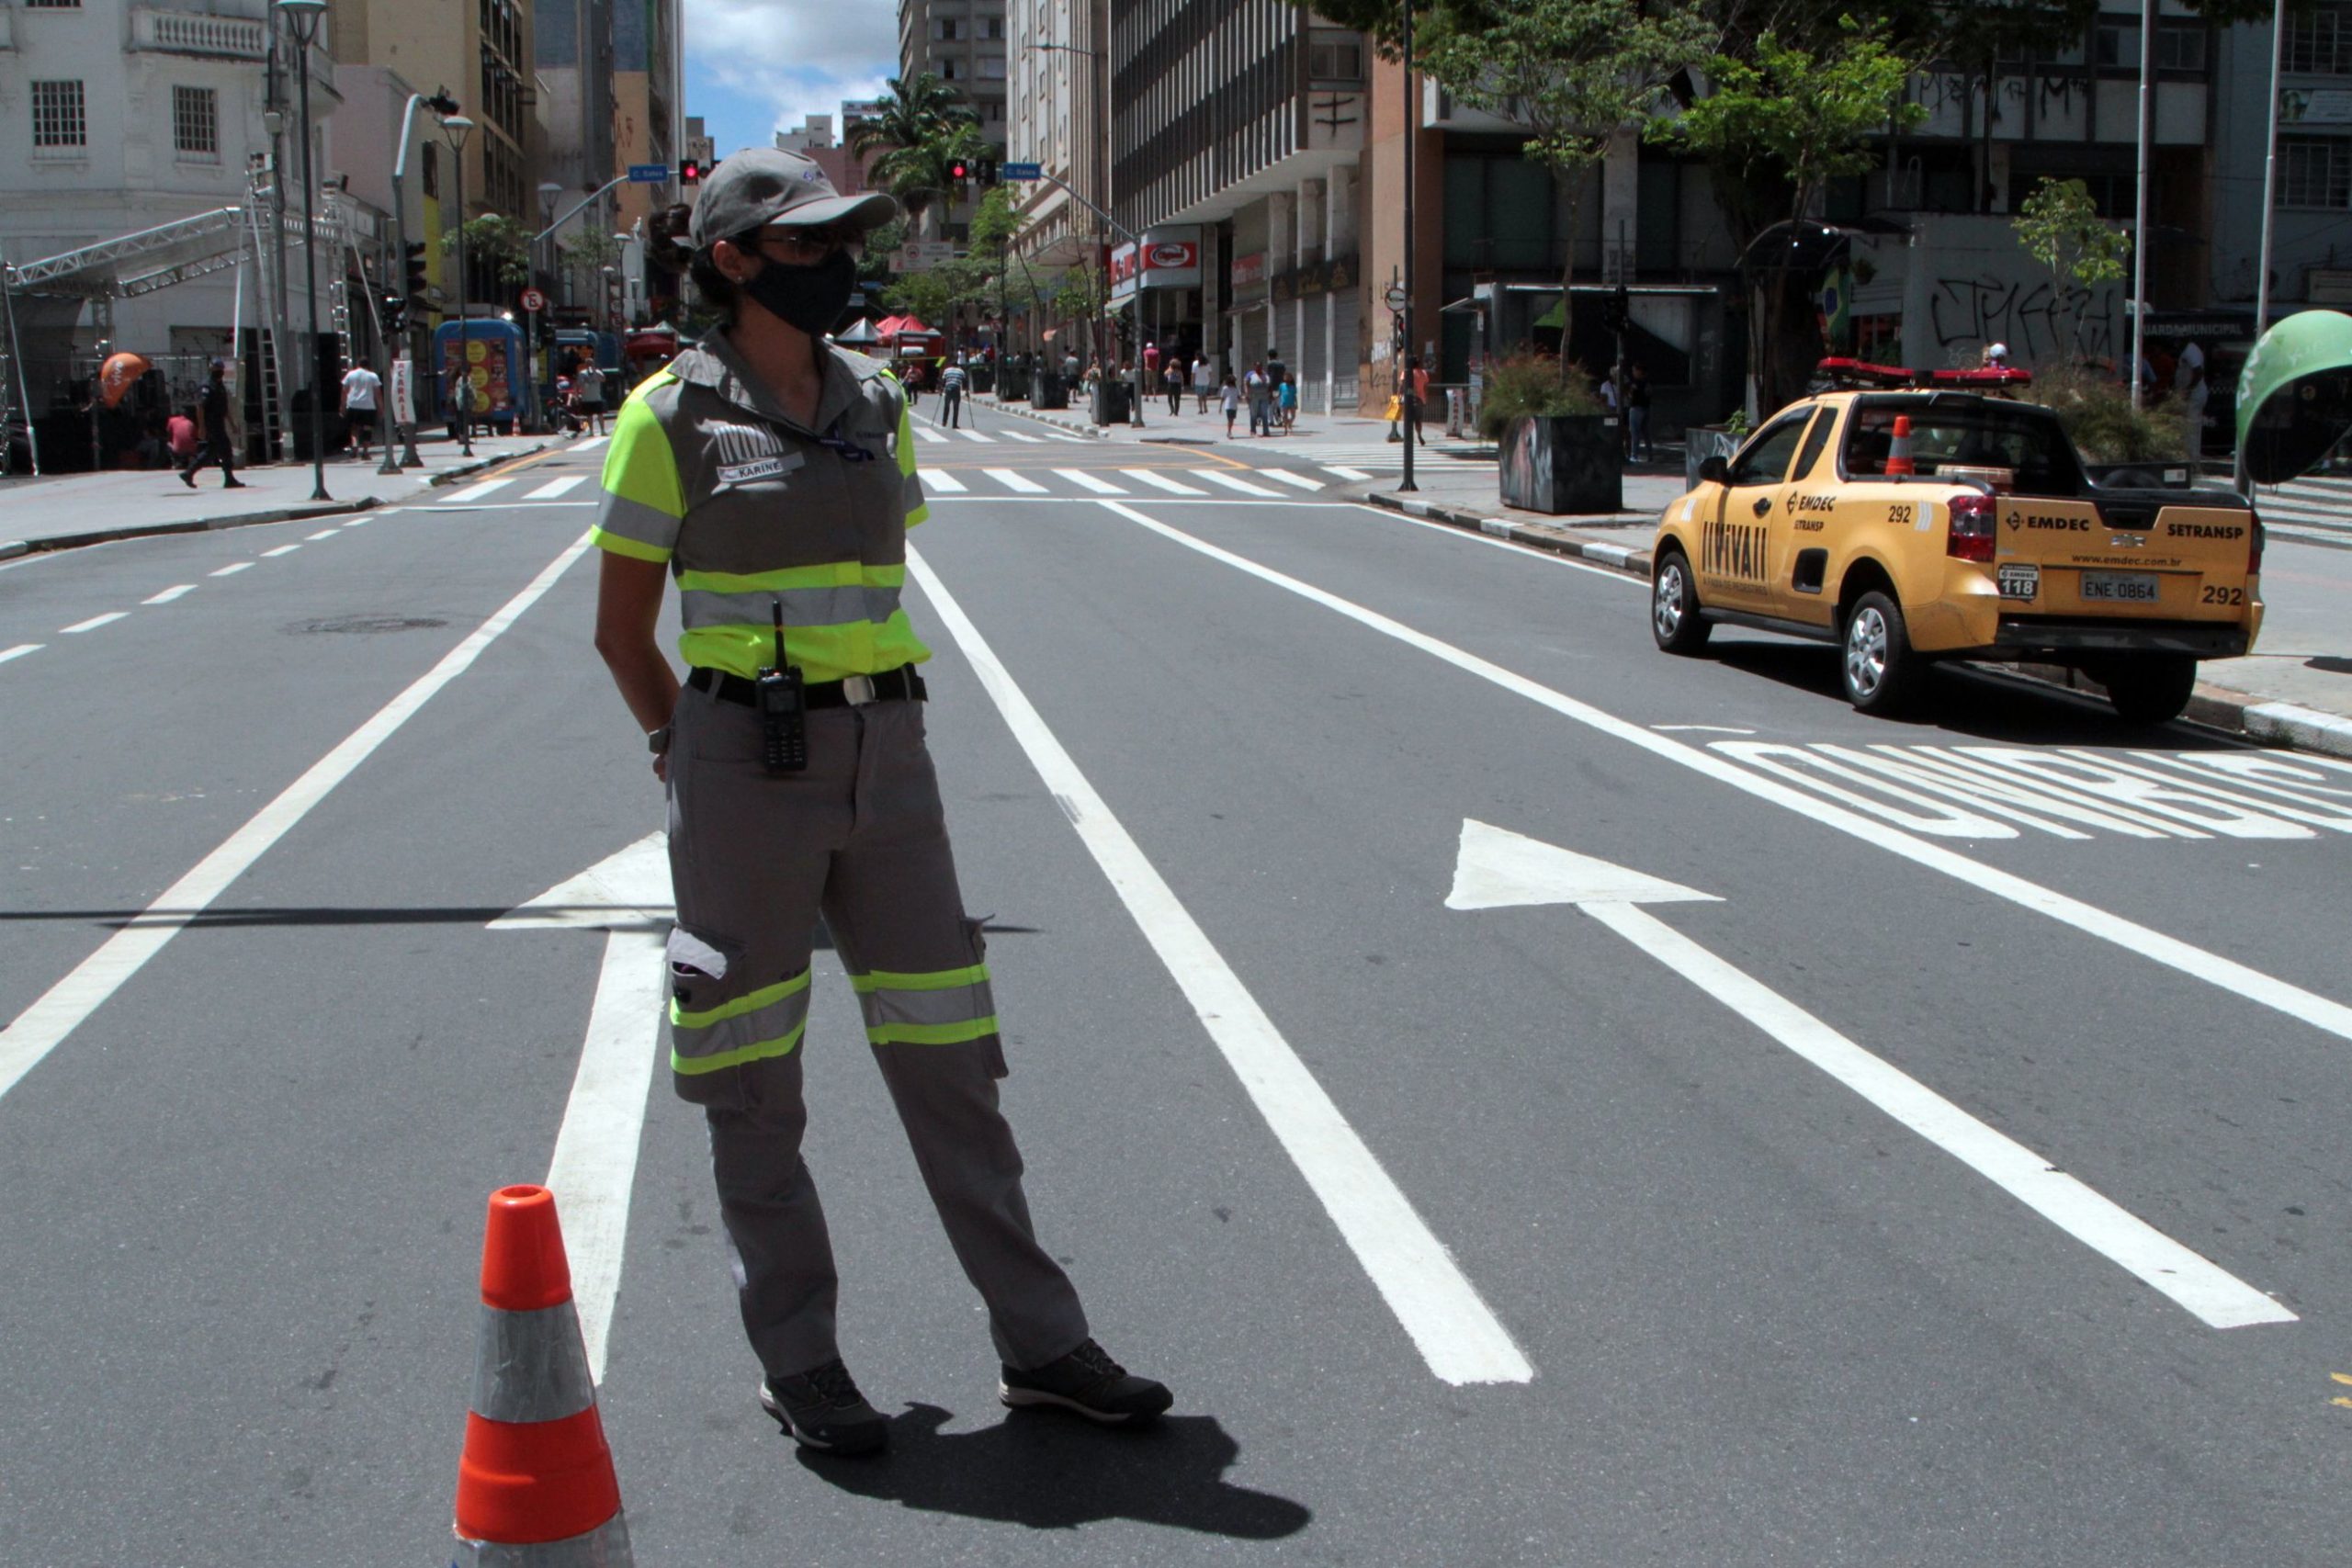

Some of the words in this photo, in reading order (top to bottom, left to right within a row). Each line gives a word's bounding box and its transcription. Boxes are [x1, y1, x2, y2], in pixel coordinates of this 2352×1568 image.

[2143, 323, 2180, 335] UARDA
[2182, 323, 2243, 335] MUNICIPAL
[739, 462, 781, 479] KARINE
[1798, 496, 1837, 513] EMDEC
[1887, 504, 1912, 524] 292
[2027, 515, 2090, 532] EMDEC
[2166, 523, 2244, 540] SETRANSP
[2072, 554, 2182, 568] www.emdec.com.br
[2002, 580, 2034, 595] 118
[2202, 585, 2243, 606] 292
